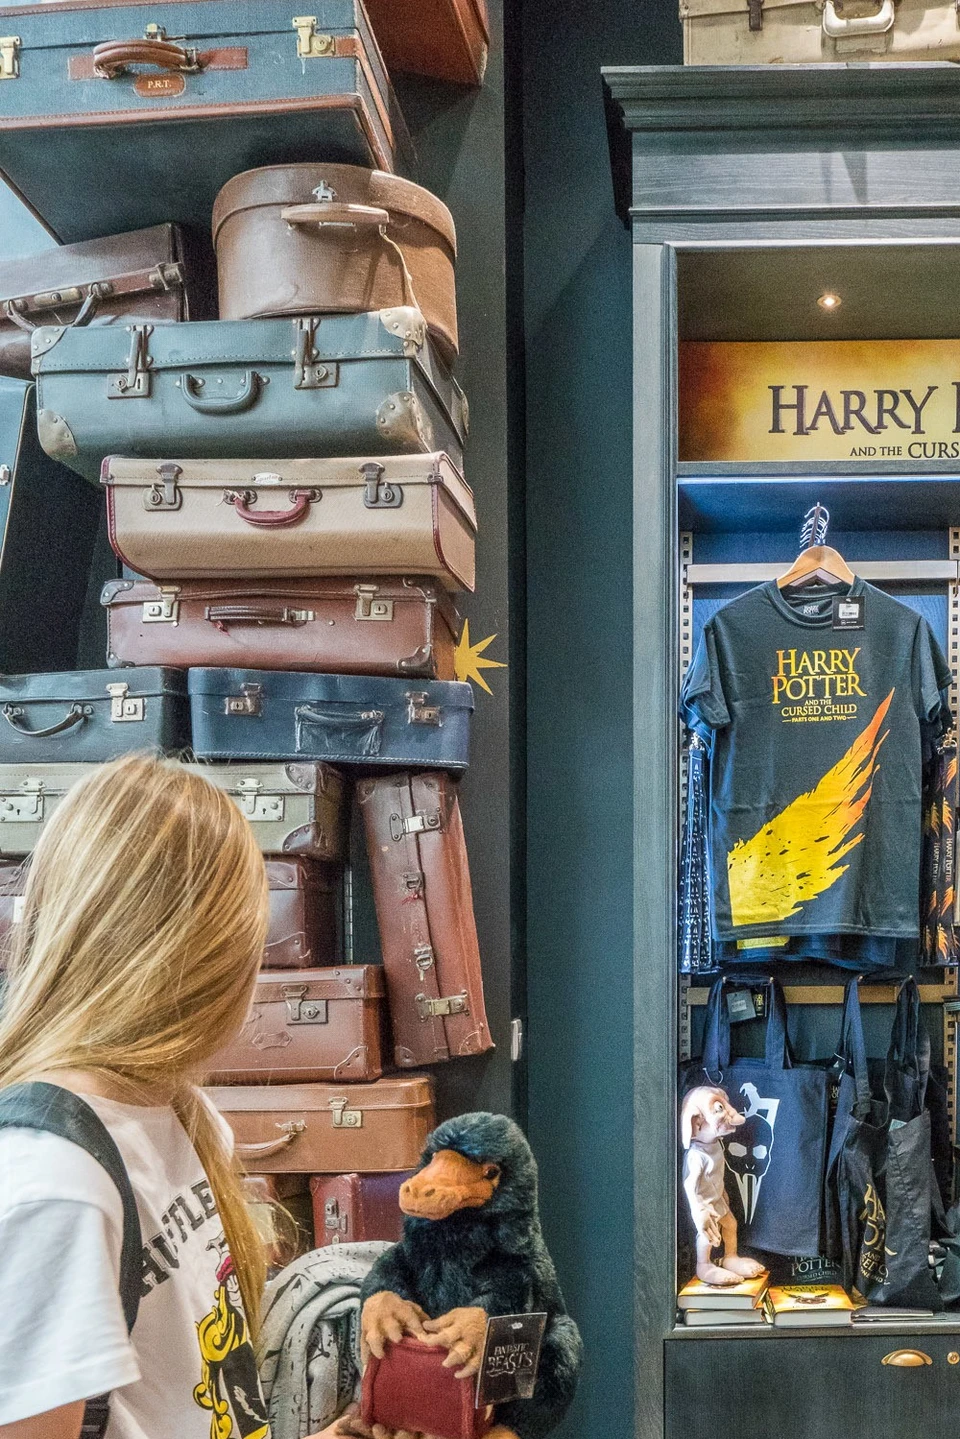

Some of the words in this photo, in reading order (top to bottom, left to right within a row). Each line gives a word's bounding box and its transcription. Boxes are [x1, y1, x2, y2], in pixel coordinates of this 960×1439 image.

[147, 79, 172, 89] P.R.T.
[767, 384, 939, 435] HARRY
[850, 445, 877, 458] AND
[880, 445, 903, 457] THE
[775, 647, 861, 677] HARRY
[771, 673, 867, 704] POTTER
[781, 705, 822, 717] CURSED
[824, 704, 858, 715] CHILD
[486, 1352, 534, 1377] BEASTS
